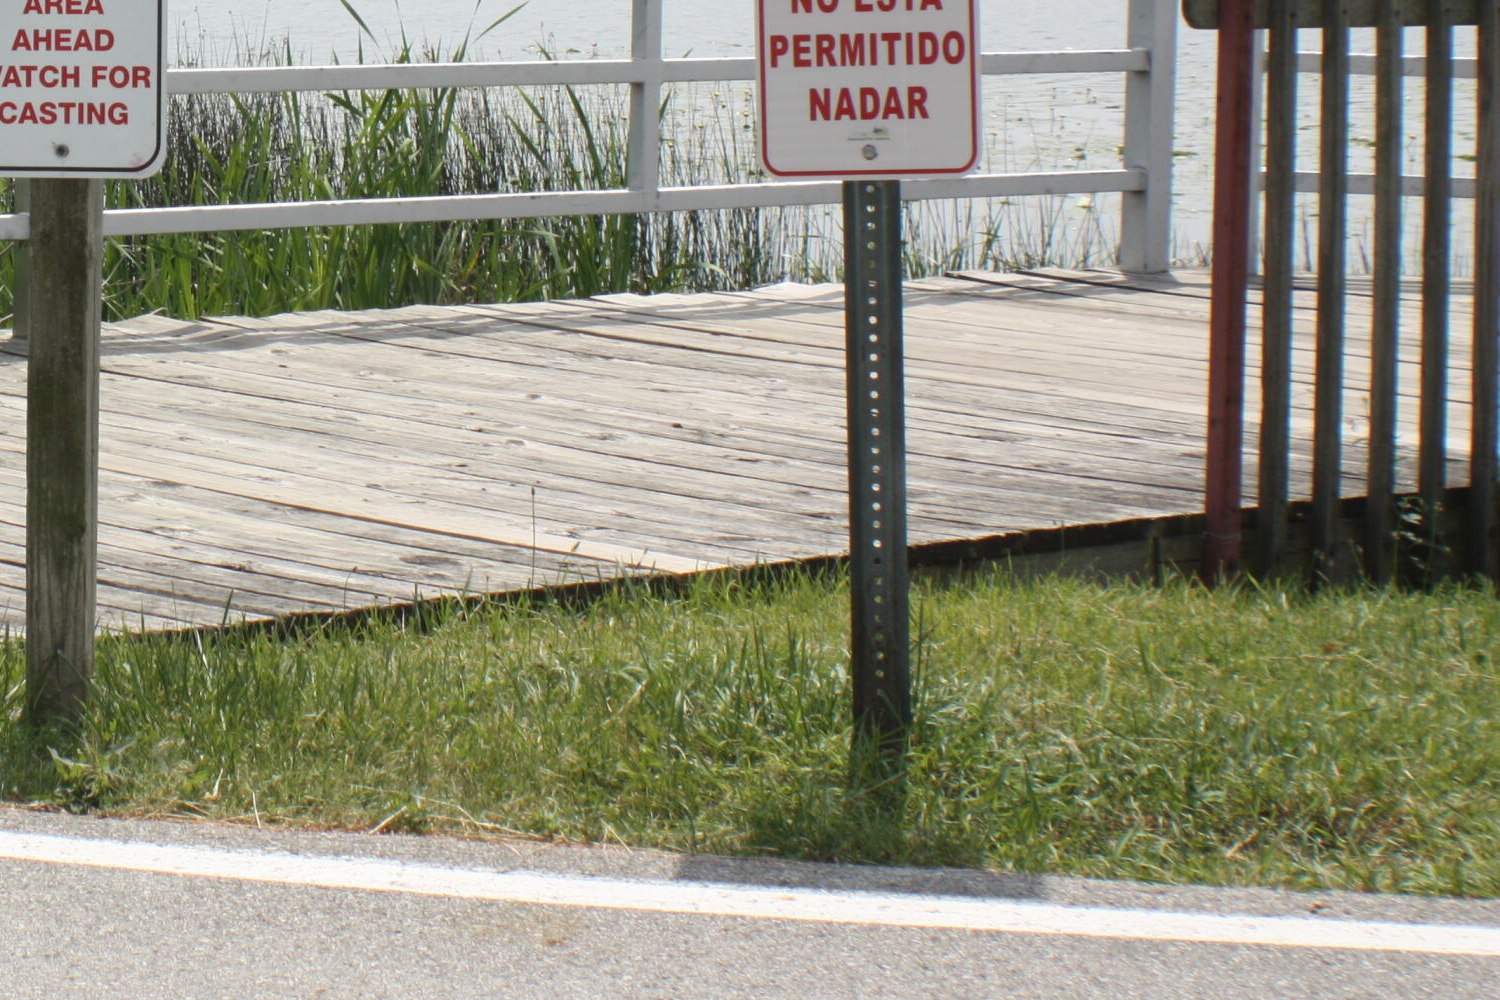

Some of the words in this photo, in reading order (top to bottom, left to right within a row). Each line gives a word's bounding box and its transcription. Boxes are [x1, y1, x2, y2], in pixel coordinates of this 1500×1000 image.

[11, 29, 115, 51] AHEAD
[770, 31, 965, 68] PERMITIDO
[92, 66, 151, 88] FOR
[809, 86, 929, 121] NADAR
